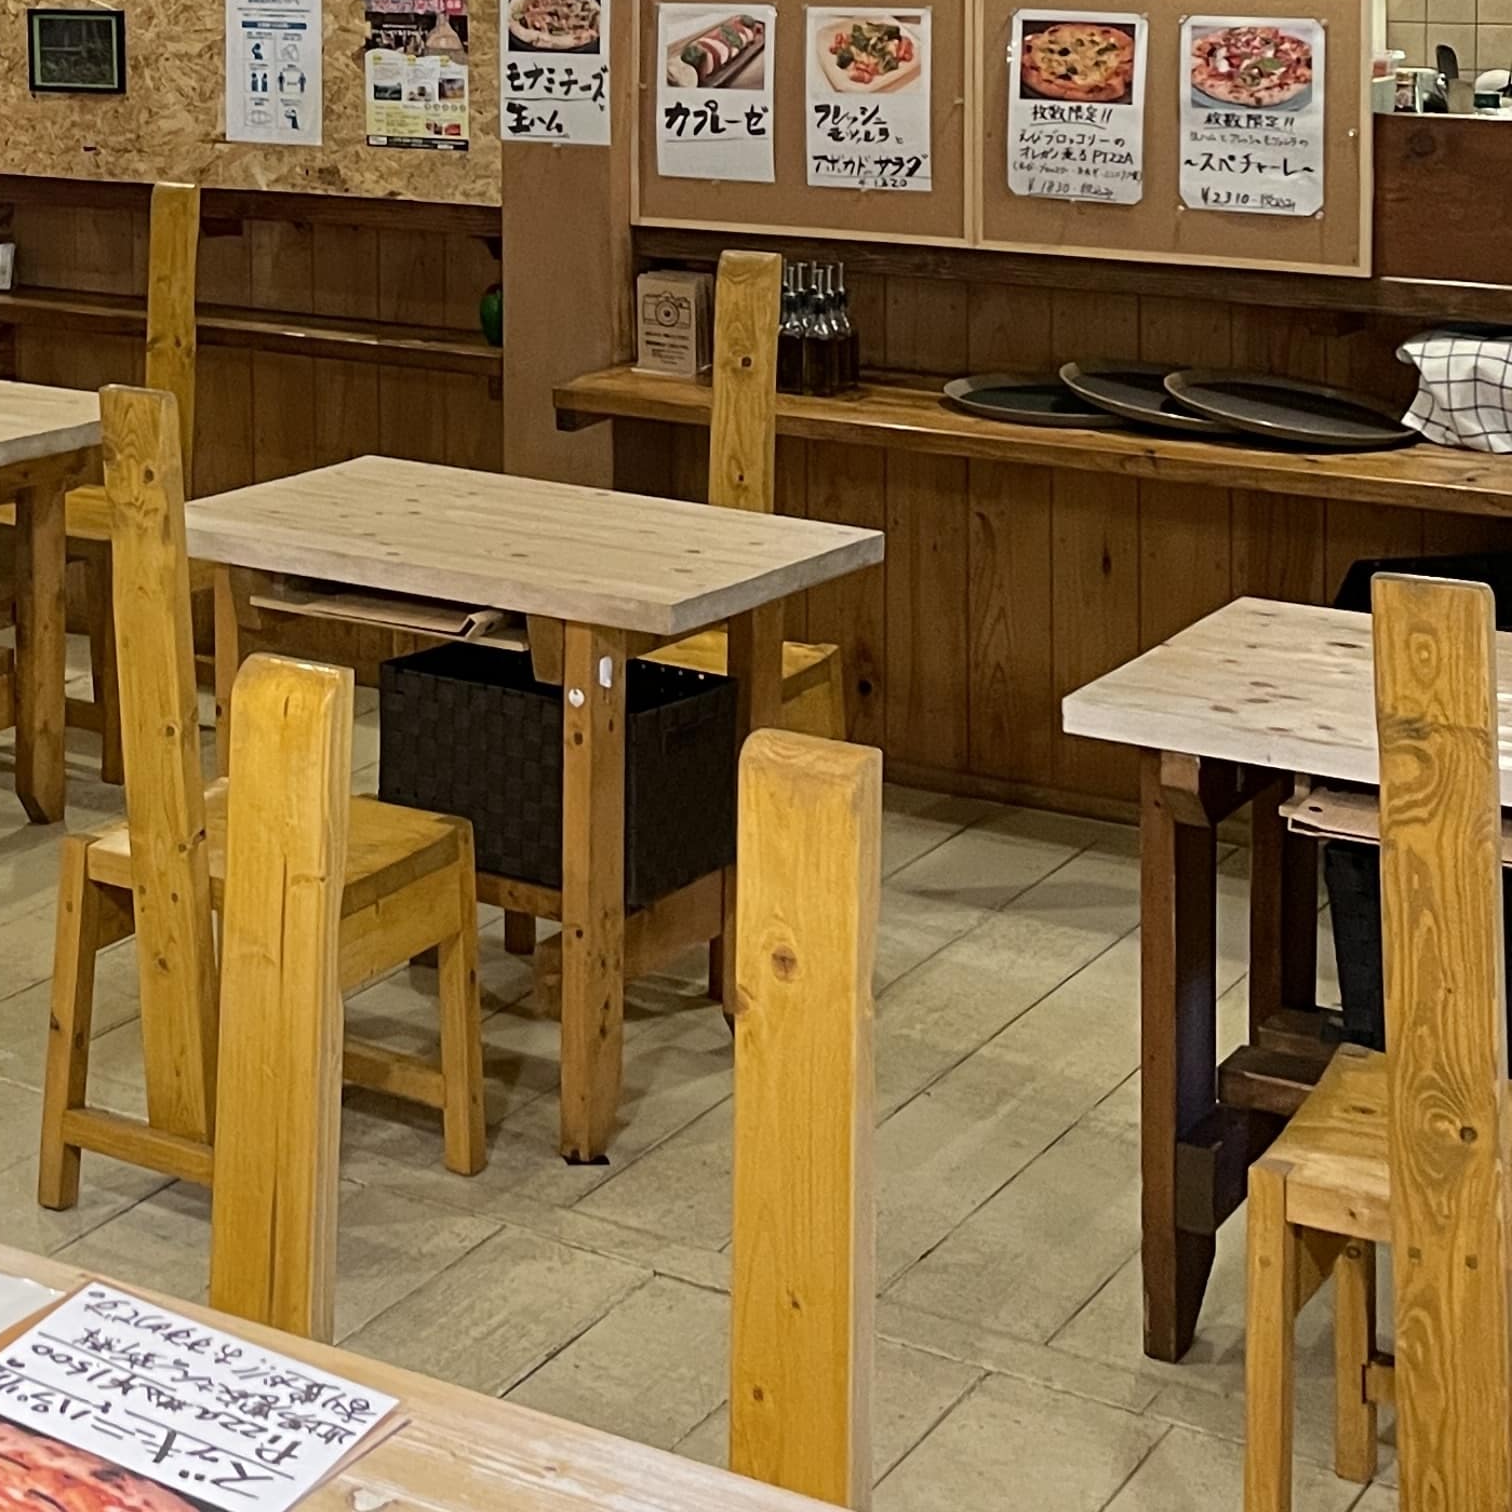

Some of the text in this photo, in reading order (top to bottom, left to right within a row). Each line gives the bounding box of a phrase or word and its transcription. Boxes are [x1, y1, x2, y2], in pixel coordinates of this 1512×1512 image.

[664, 99, 769, 137] カプレーゼ
